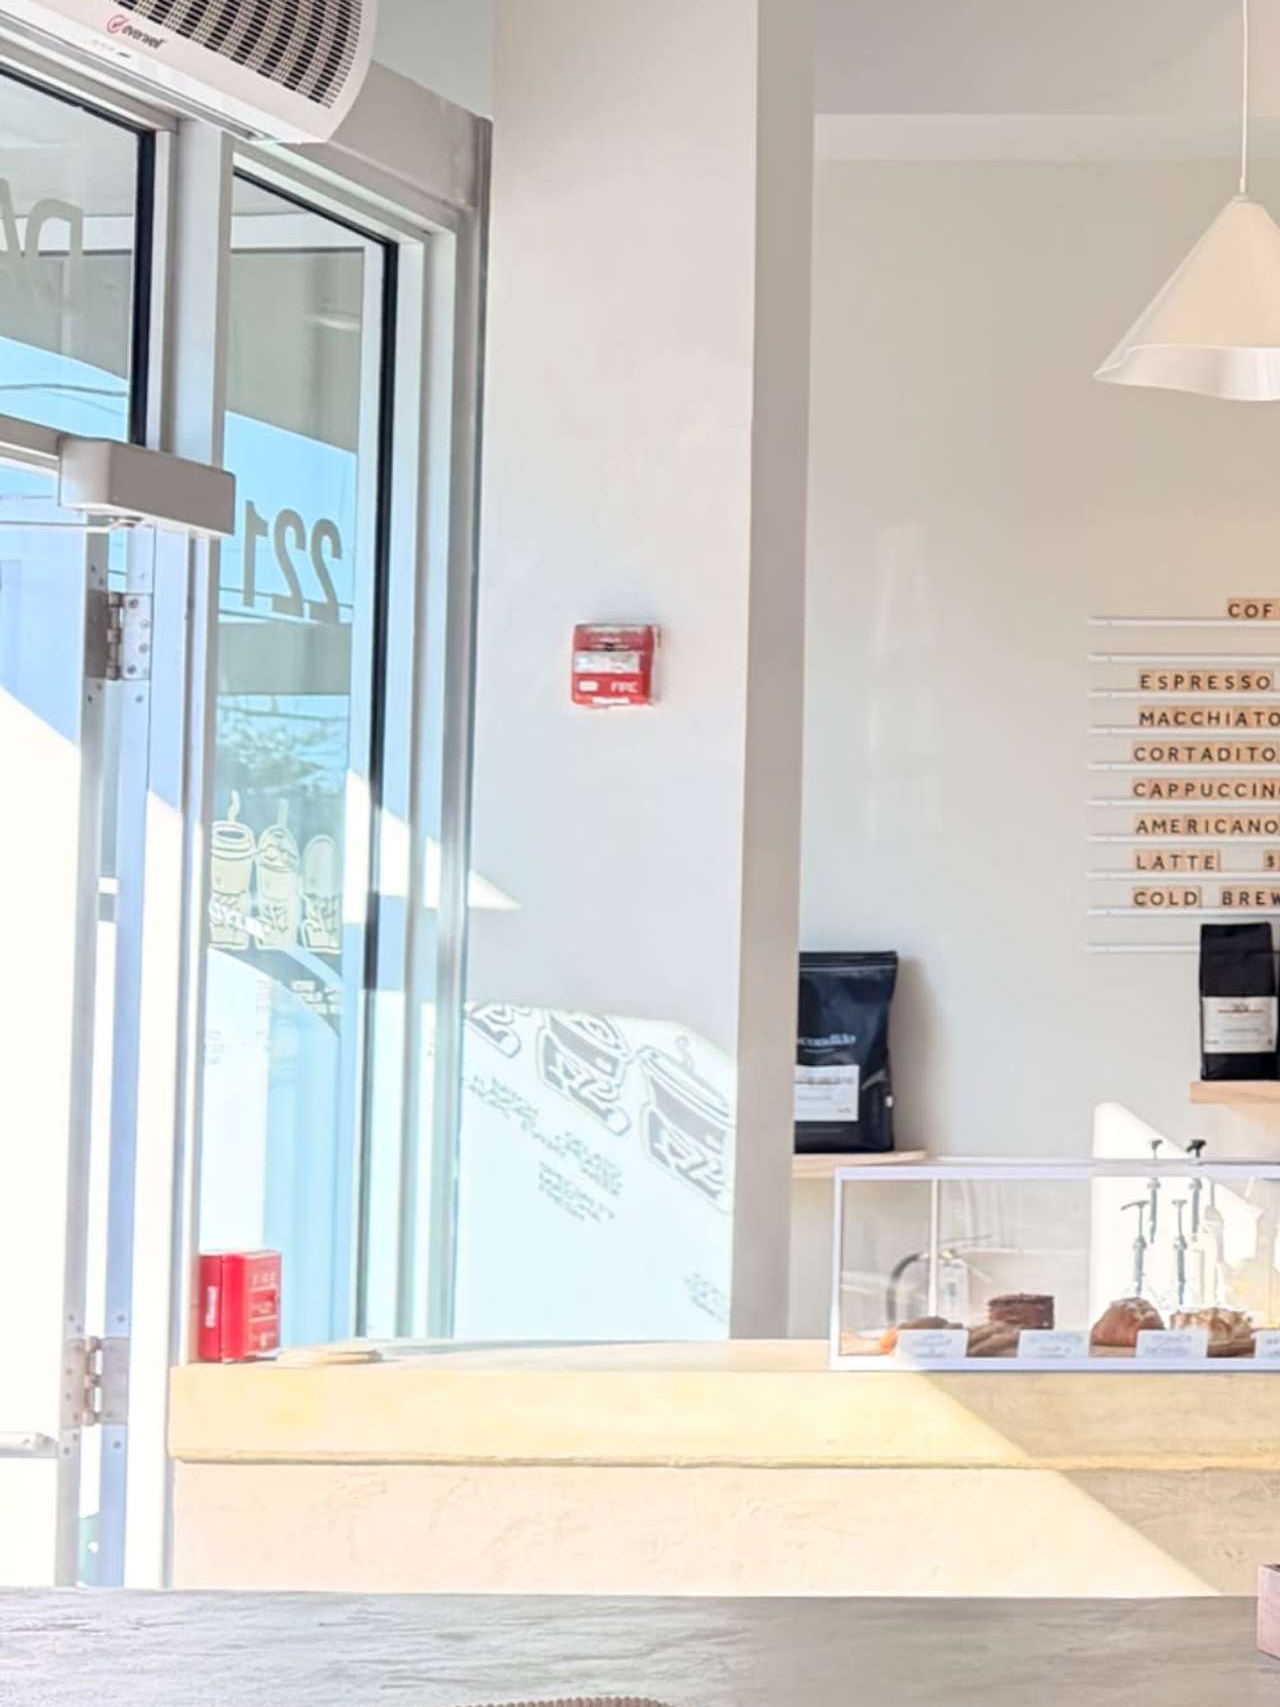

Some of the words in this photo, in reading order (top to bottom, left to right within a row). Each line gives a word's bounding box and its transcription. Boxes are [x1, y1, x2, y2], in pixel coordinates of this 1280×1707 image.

[1140, 674, 1270, 690] ESPRESSO
[1134, 746, 1276, 762] CORTADITO
[1136, 818, 1279, 834] AMERICANO
[1137, 854, 1214, 870] LATTE
[1134, 891, 1197, 906] COLD
